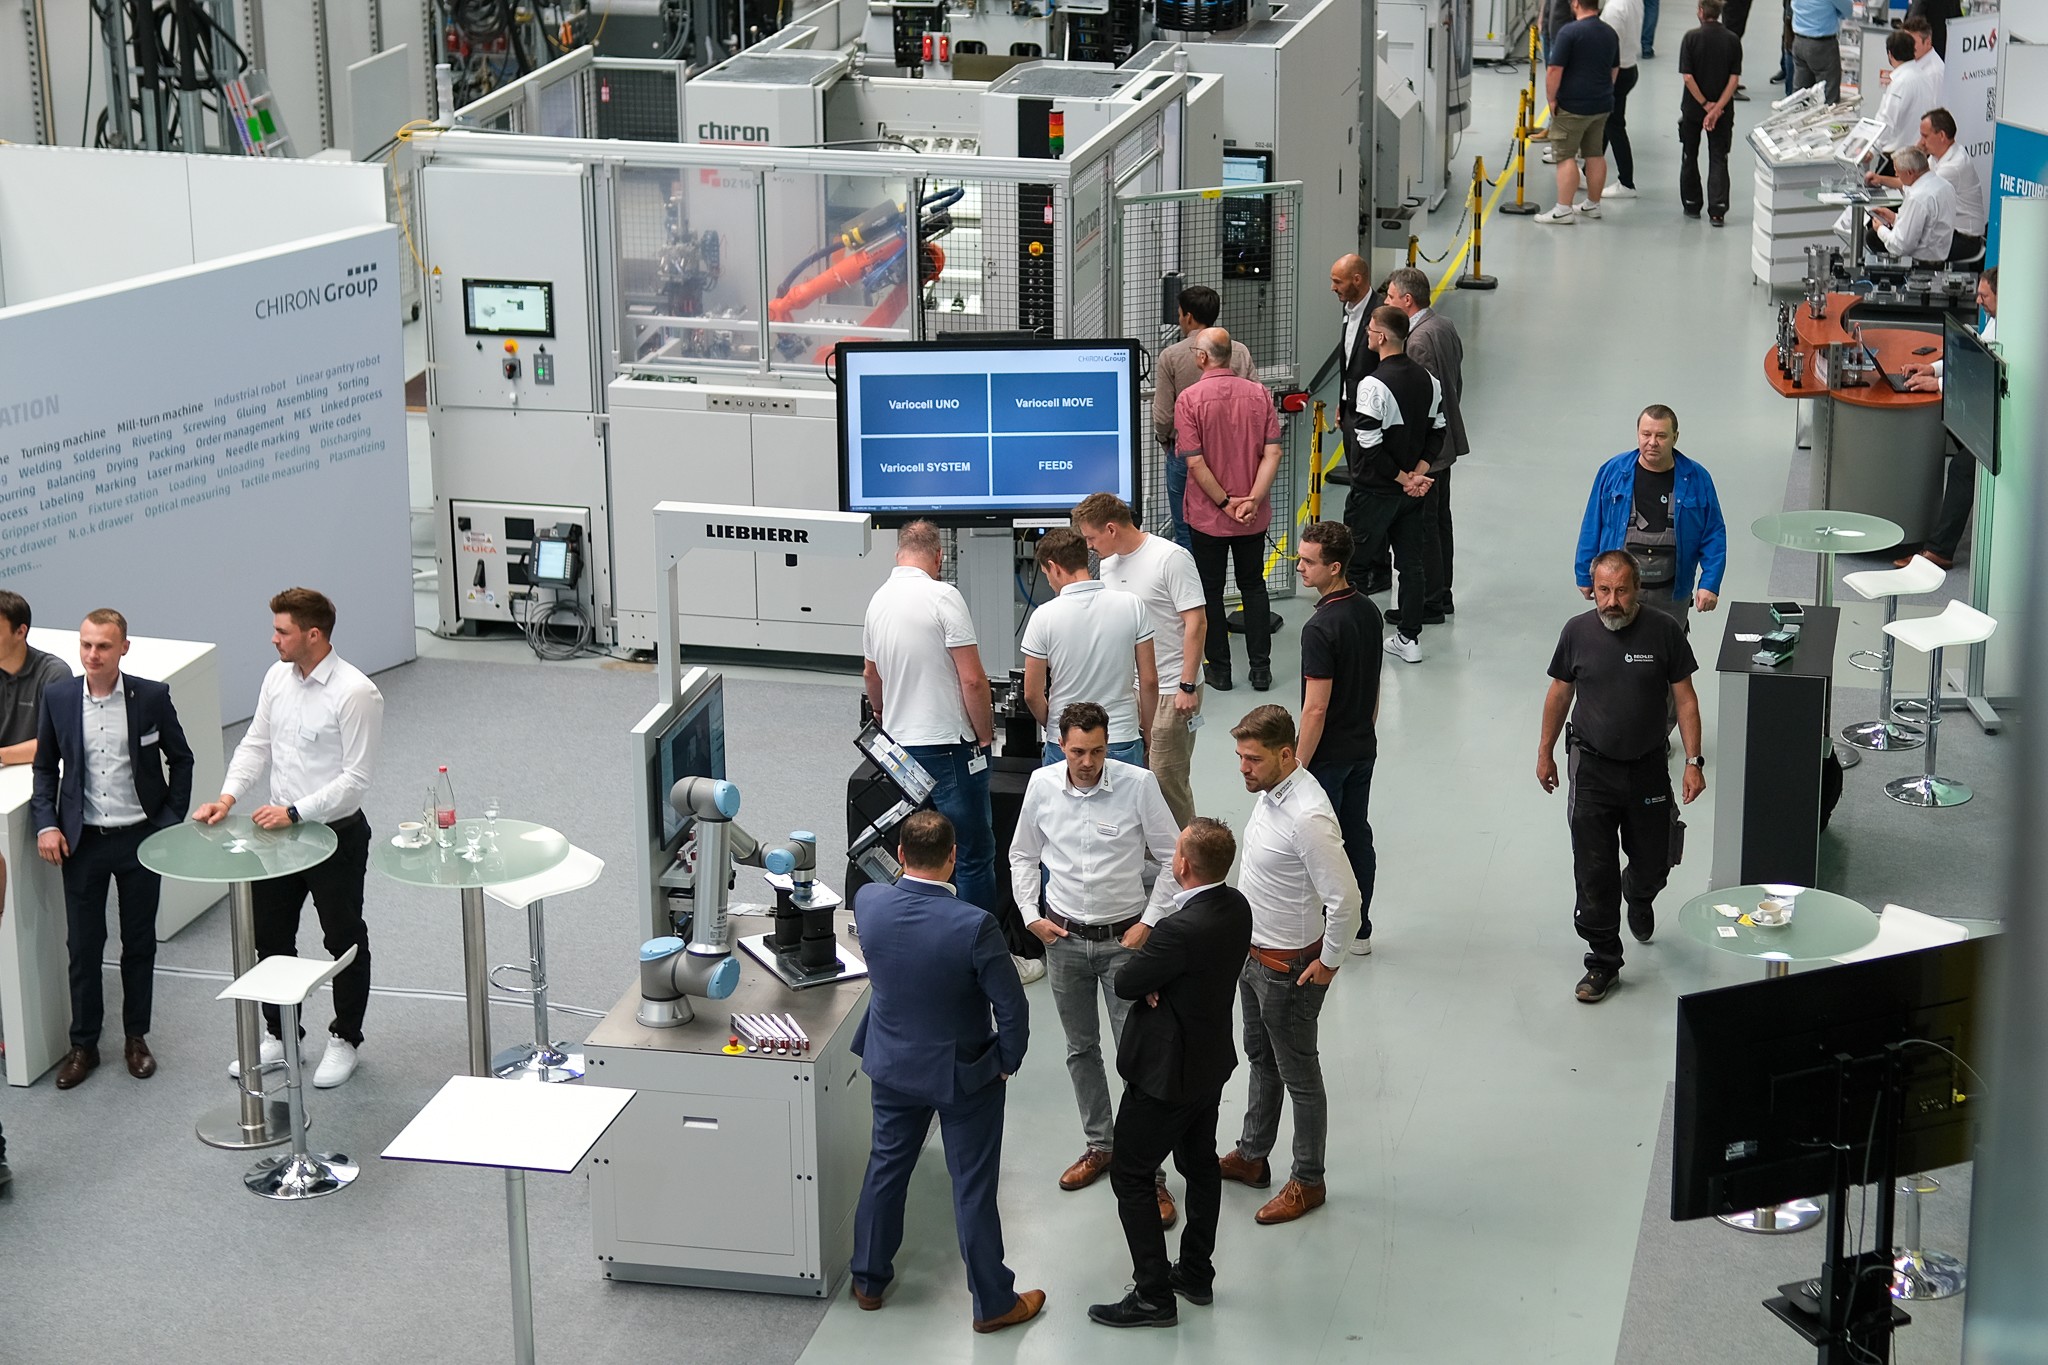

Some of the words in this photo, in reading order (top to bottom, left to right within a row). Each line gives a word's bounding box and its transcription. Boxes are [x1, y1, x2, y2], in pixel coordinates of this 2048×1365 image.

[698, 121, 769, 142] chiron
[1999, 173, 2016, 193] THE
[255, 286, 320, 319] CHIRON
[324, 277, 378, 302] Group
[21, 441, 60, 459] Turning
[63, 428, 106, 449] machine
[117, 414, 160, 433] Mill-turn
[162, 402, 204, 421] machine
[214, 386, 259, 407] Industrial
[261, 380, 286, 395] robot
[296, 370, 323, 386] Linear
[325, 362, 354, 379] gantry
[356, 354, 380, 369] robot
[889, 399, 933, 410] Variocell
[936, 399, 960, 410] UNO
[1015, 398, 1060, 409] Variocell
[1062, 397, 1094, 408] MOVE
[19, 459, 62, 479] Welding
[73, 442, 121, 464] Soldering
[132, 429, 173, 448] Riveting
[183, 414, 226, 434] Screwing
[237, 403, 267, 420] Gluing
[276, 386, 328, 408] Assembling
[338, 376, 369, 392] Sorting
[47, 469, 96, 490] Balancing
[106, 456, 139, 474] Drying
[149, 443, 186, 462] Packing
[196, 432, 221, 449] Order
[223, 415, 284, 441] management
[294, 407, 312, 421] MES
[321, 395, 350, 414] Linked
[351, 389, 383, 407] process
[40, 490, 84, 511] Labeling
[95, 475, 137, 494] Marking
[147, 464, 172, 480] Laser
[174, 453, 215, 472] marking
[225, 440, 259, 458] Needle
[261, 430, 300, 448] marking
[309, 420, 334, 434] Write
[336, 412, 361, 427] codes
[880, 463, 925, 473] Variocell
[926, 462, 971, 473] SYSTEM
[1038, 460, 1073, 471] FEED5
[2, 521, 40, 540] Gripper
[42, 511, 77, 529] station
[89, 497, 122, 515] Fixture
[125, 488, 159, 505] station
[169, 474, 207, 492] Loading
[217, 457, 265, 478] Unloading
[274, 444, 310, 462] Feeding
[320, 427, 371, 449] Discharging
[20, 535, 57, 554] drawer
[98, 513, 134, 531] drawer
[145, 499, 178, 519] Optical
[181, 484, 231, 506] measuring
[241, 474, 270, 490] Tactile
[272, 459, 320, 481] measuring
[329, 439, 386, 463] Plasmatizing
[706, 524, 809, 543] LIEBHERR
[463, 545, 497, 555] KUKA
